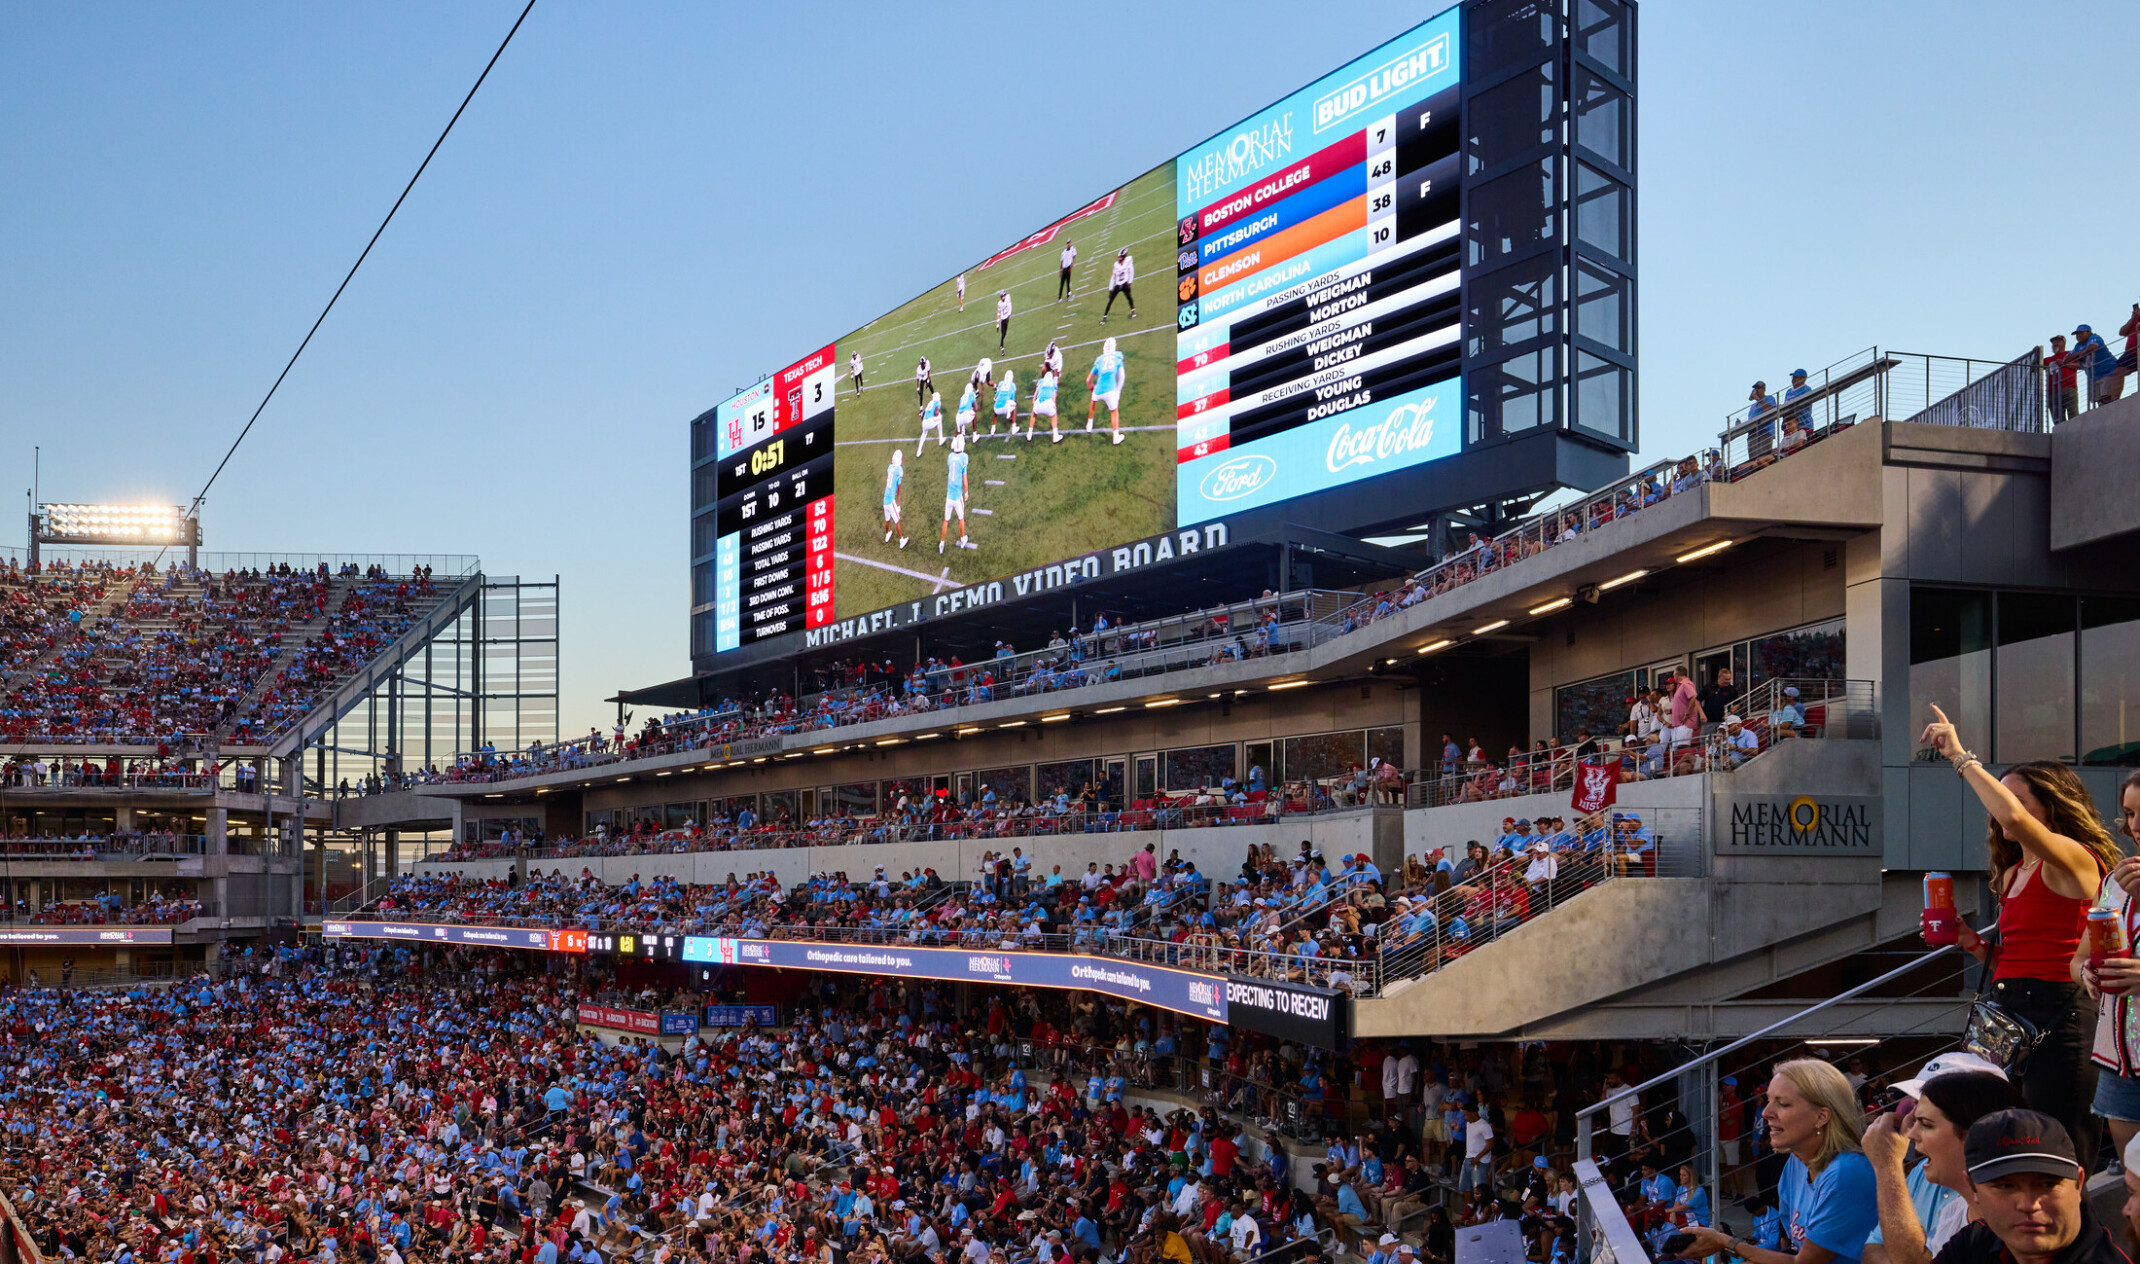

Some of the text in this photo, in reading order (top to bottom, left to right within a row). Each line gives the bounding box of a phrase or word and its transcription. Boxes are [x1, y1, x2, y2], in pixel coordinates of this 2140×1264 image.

[1317, 42, 1443, 126] BUD LIGHT
[1420, 111, 1431, 130] F
[1376, 129, 1386, 144] 7
[1188, 114, 1293, 181] MEMORIAL
[1187, 133, 1291, 203] HERMANN
[1371, 160, 1391, 179] 48
[1204, 165, 1310, 228] BOSTON COLLEGE
[1420, 180, 1431, 198] F
[1372, 193, 1391, 213] 38
[1204, 212, 1278, 257] PITTSBURGH
[1373, 227, 1390, 245] 10
[1204, 251, 1261, 286] CLEMSON
[1204, 261, 1311, 315] NORTH CAROLINA
[1266, 271, 1340, 308] PASSING YARDS
[1306, 272, 1372, 307] WEIGMAN
[1310, 291, 1368, 324] MORTON
[1266, 320, 1341, 355] RUSHING YARDS
[1306, 323, 1372, 357] WEIGMAN
[1194, 353, 1208, 367] 70
[1314, 344, 1363, 371] DICKEY
[784, 355, 823, 383] TEXAS TECH
[814, 382, 822, 403] 3
[1262, 368, 1345, 403] RECEIVING YARDS
[1315, 376, 1362, 401] YOUNG
[731, 390, 759, 411] HOUSTON
[1194, 398, 1208, 412] 37
[1307, 391, 1371, 421] DOUGLAS
[752, 411, 765, 432] 15
[1326, 396, 1438, 473] Coca-Cola
[751, 439, 784, 476] 0:51
[1194, 443, 1208, 456] 42
[795, 481, 806, 498] 21
[1213, 461, 1262, 497] Ford
[741, 501, 757, 519] 1ST
[768, 492, 779, 508] 10
[814, 500, 826, 516] 52
[751, 515, 792, 538] RUSHING YARDS
[814, 518, 826, 534] 70
[751, 532, 792, 555] PASSING YARDS
[812, 535, 828, 552] 122
[754, 551, 789, 571] TOTAL YARDS
[816, 555, 823, 569] 6
[754, 568, 789, 588] FIRST DOWNS
[805, 609, 899, 648] MICHAEL
[1013, 555, 1101, 598] VIDEO
[1112, 522, 1229, 573] BOARD
[760, 589, 777, 604] DOWN
[777, 584, 794, 600] CONV.
[753, 609, 766, 622] TIME
[766, 608, 773, 619] OF
[816, 608, 823, 622] 0
[756, 621, 786, 638] TURNOVERS
[745, 740, 780, 755] HERMANN
[1731, 801, 1871, 827] MEMORIAL
[1730, 822, 1871, 847] HERMANN
[807, 950, 912, 969] Orthopedic care tailored to you.
[969, 956, 1001, 966] MEMORIAL
[969, 962, 1000, 973] HERMANN
[1072, 965, 1107, 982] Orthopedic
[1107, 972, 1116, 983] care
[1116, 971, 1135, 987] tailored
[1226, 982, 1329, 1021] EXPECTING TO RECEIV
